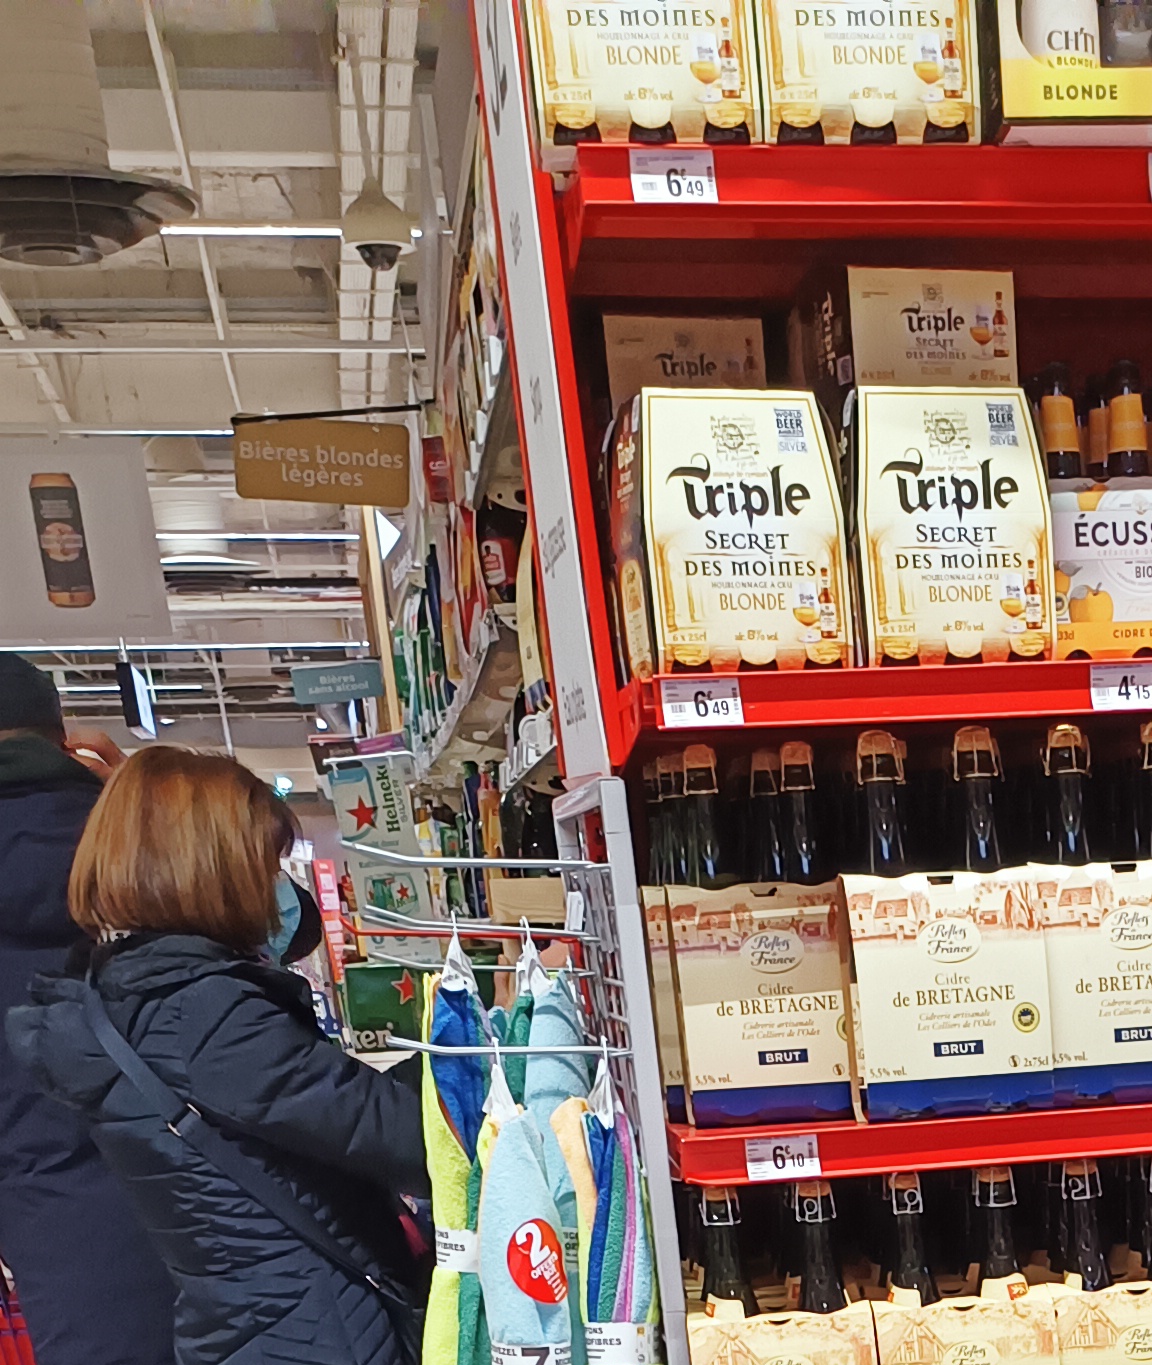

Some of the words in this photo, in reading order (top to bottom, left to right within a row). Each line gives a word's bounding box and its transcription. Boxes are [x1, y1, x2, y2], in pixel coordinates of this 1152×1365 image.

[567, 9, 609, 28] DES
[796, 9, 837, 28] DES
[607, 45, 683, 66] BLONDE
[834, 45, 906, 66] BLONDE
[1043, 84, 1118, 101] BLONDE
[901, 303, 966, 336] Triple
[655, 353, 718, 380] Triple
[776, 417, 803, 430] BEER
[989, 412, 1014, 425] BEER
[239, 441, 310, 463] Bières
[316, 448, 404, 470] blondes
[281, 462, 364, 488] légères
[666, 453, 811, 528] Triple
[880, 447, 1019, 523] Triple
[705, 529, 790, 554] SECRET
[916, 524, 997, 548] SECRET
[685, 559, 723, 577] DES
[896, 552, 932, 570] DES
[719, 592, 787, 611] BLONDE
[929, 584, 993, 603] BLONDE
[1113, 627, 1144, 639] CIDRE
[1117, 959, 1152, 972] Cidre
[935, 972, 970, 985] Cidre
[1075, 979, 1092, 994] de
[758, 983, 794, 996] Cidre
[893, 991, 910, 1007] de
[916, 983, 1015, 1004] BRETAGNE
[717, 1002, 734, 1017] de
[740, 994, 838, 1015] BRETAGNE
[766, 1051, 800, 1063] BRUT
[941, 1042, 976, 1055] BRUT
[515, 1221, 551, 1269] 2
